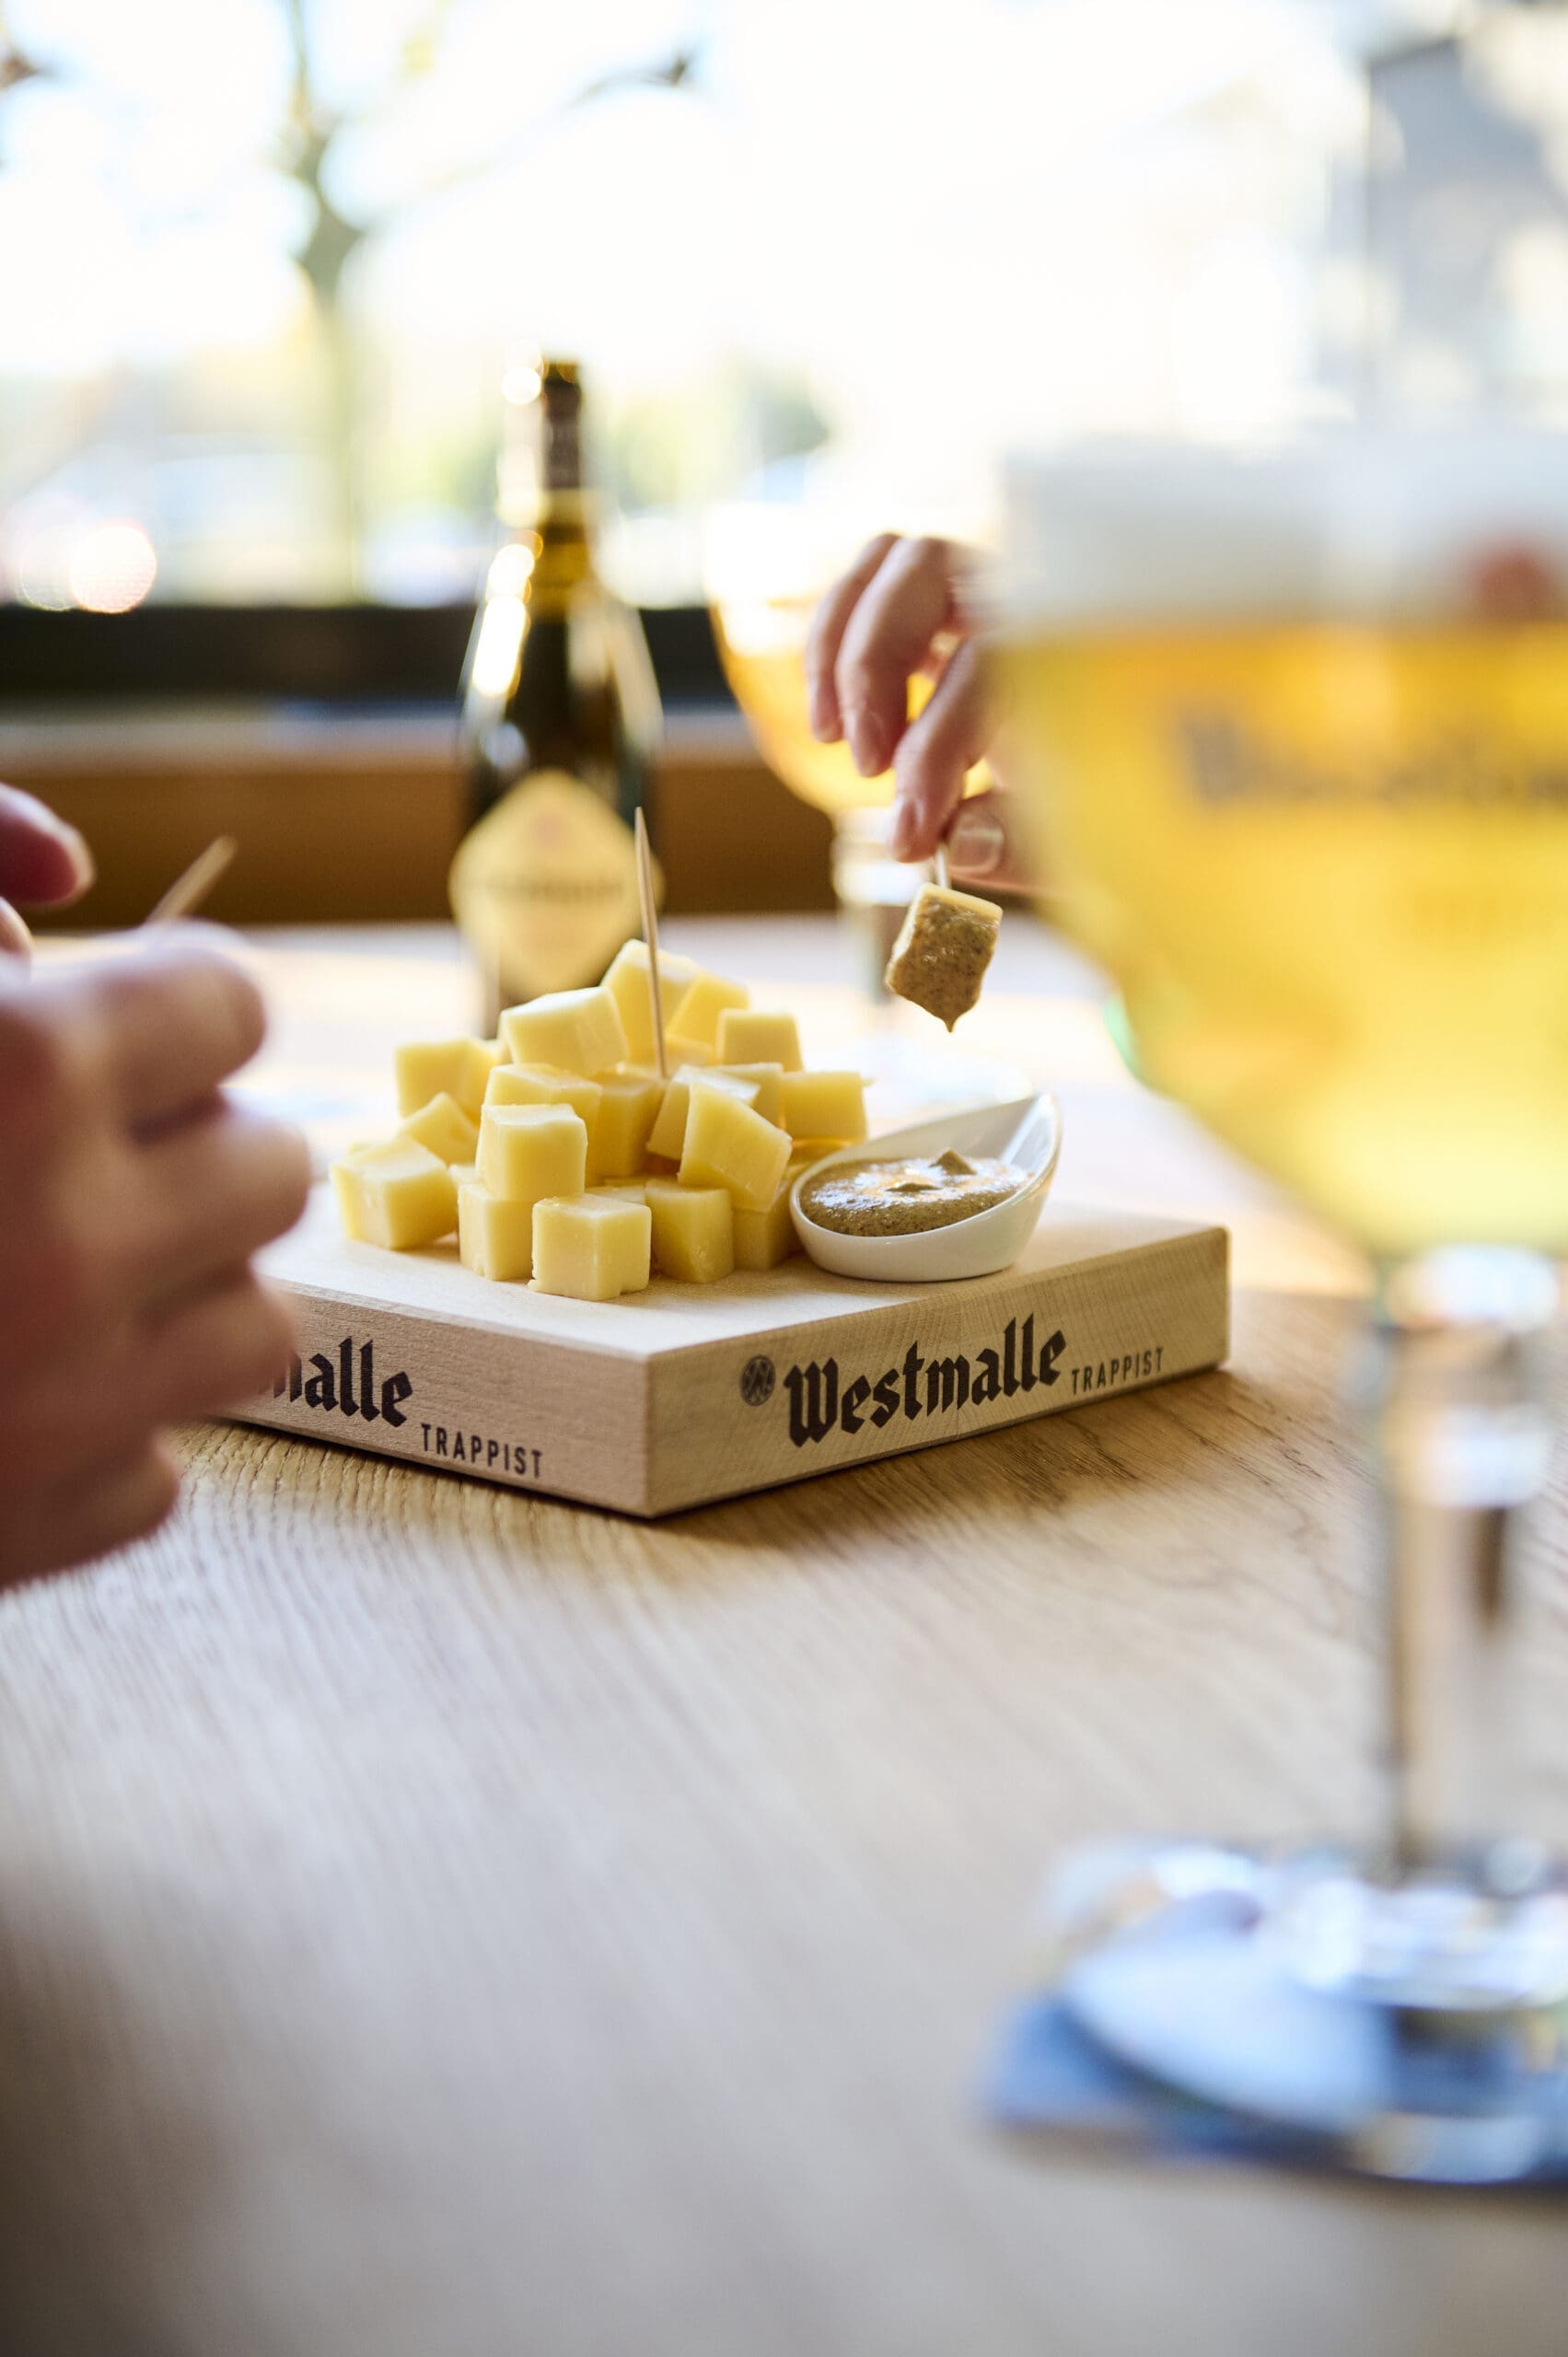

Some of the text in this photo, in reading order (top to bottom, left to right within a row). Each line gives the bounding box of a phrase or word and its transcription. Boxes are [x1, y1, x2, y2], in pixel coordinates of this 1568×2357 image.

[784, 1314, 1164, 1447] Westmalle TRAPPIST
[421, 1423, 543, 1478] TRAPPIST
